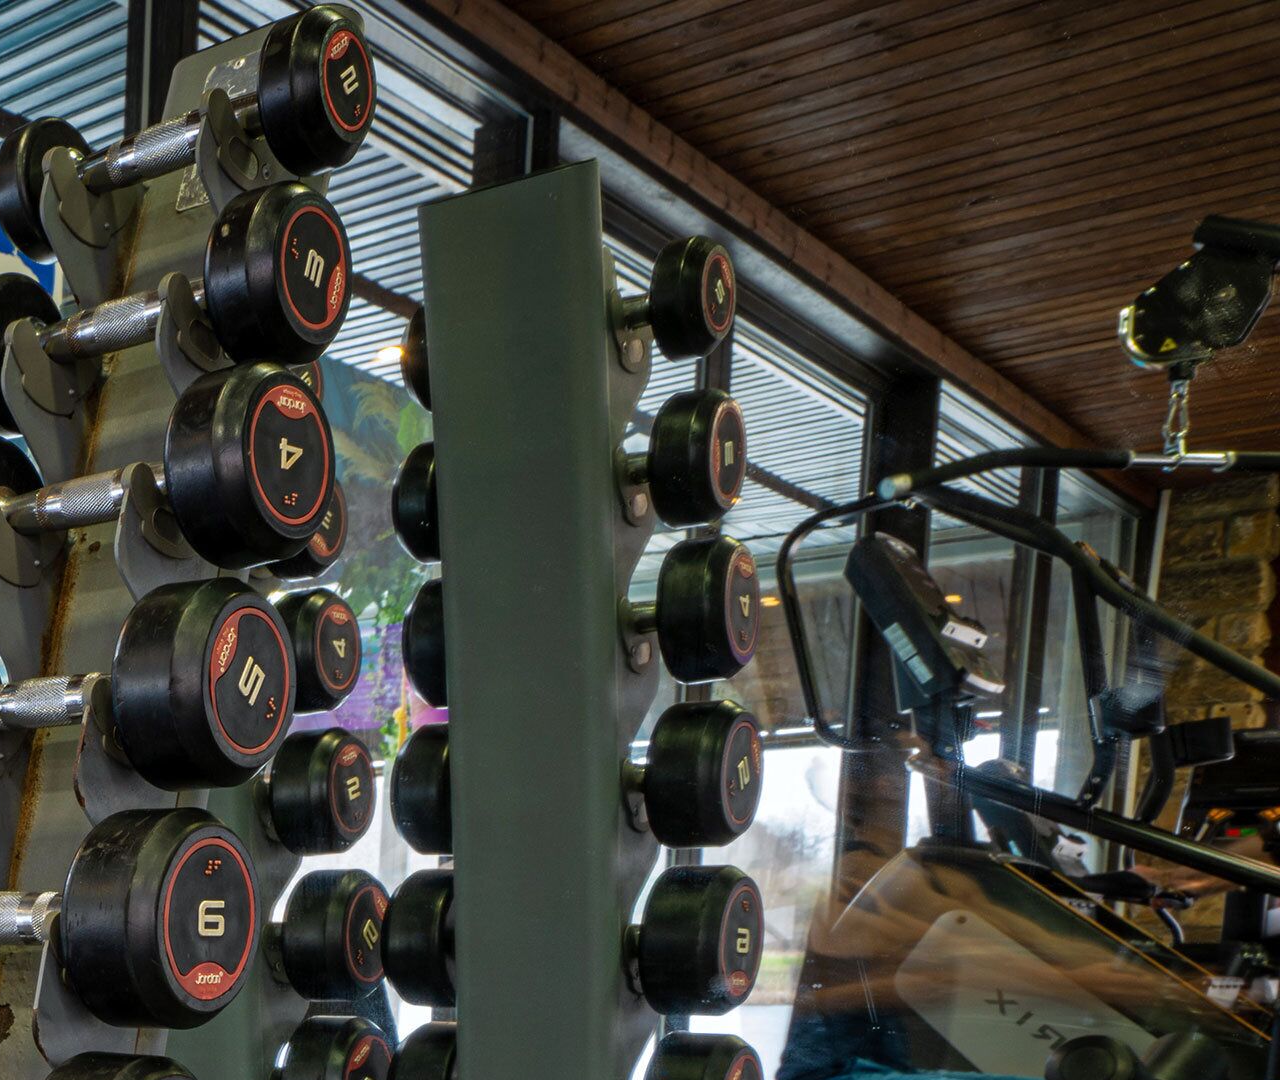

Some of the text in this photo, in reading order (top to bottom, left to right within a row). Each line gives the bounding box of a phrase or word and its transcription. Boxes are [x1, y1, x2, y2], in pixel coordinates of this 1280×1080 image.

[340, 65, 359, 95] 2
[304, 249, 325, 289] 3
[279, 437, 303, 470] 4
[238, 656, 266, 706] 5
[198, 900, 225, 937] 6
